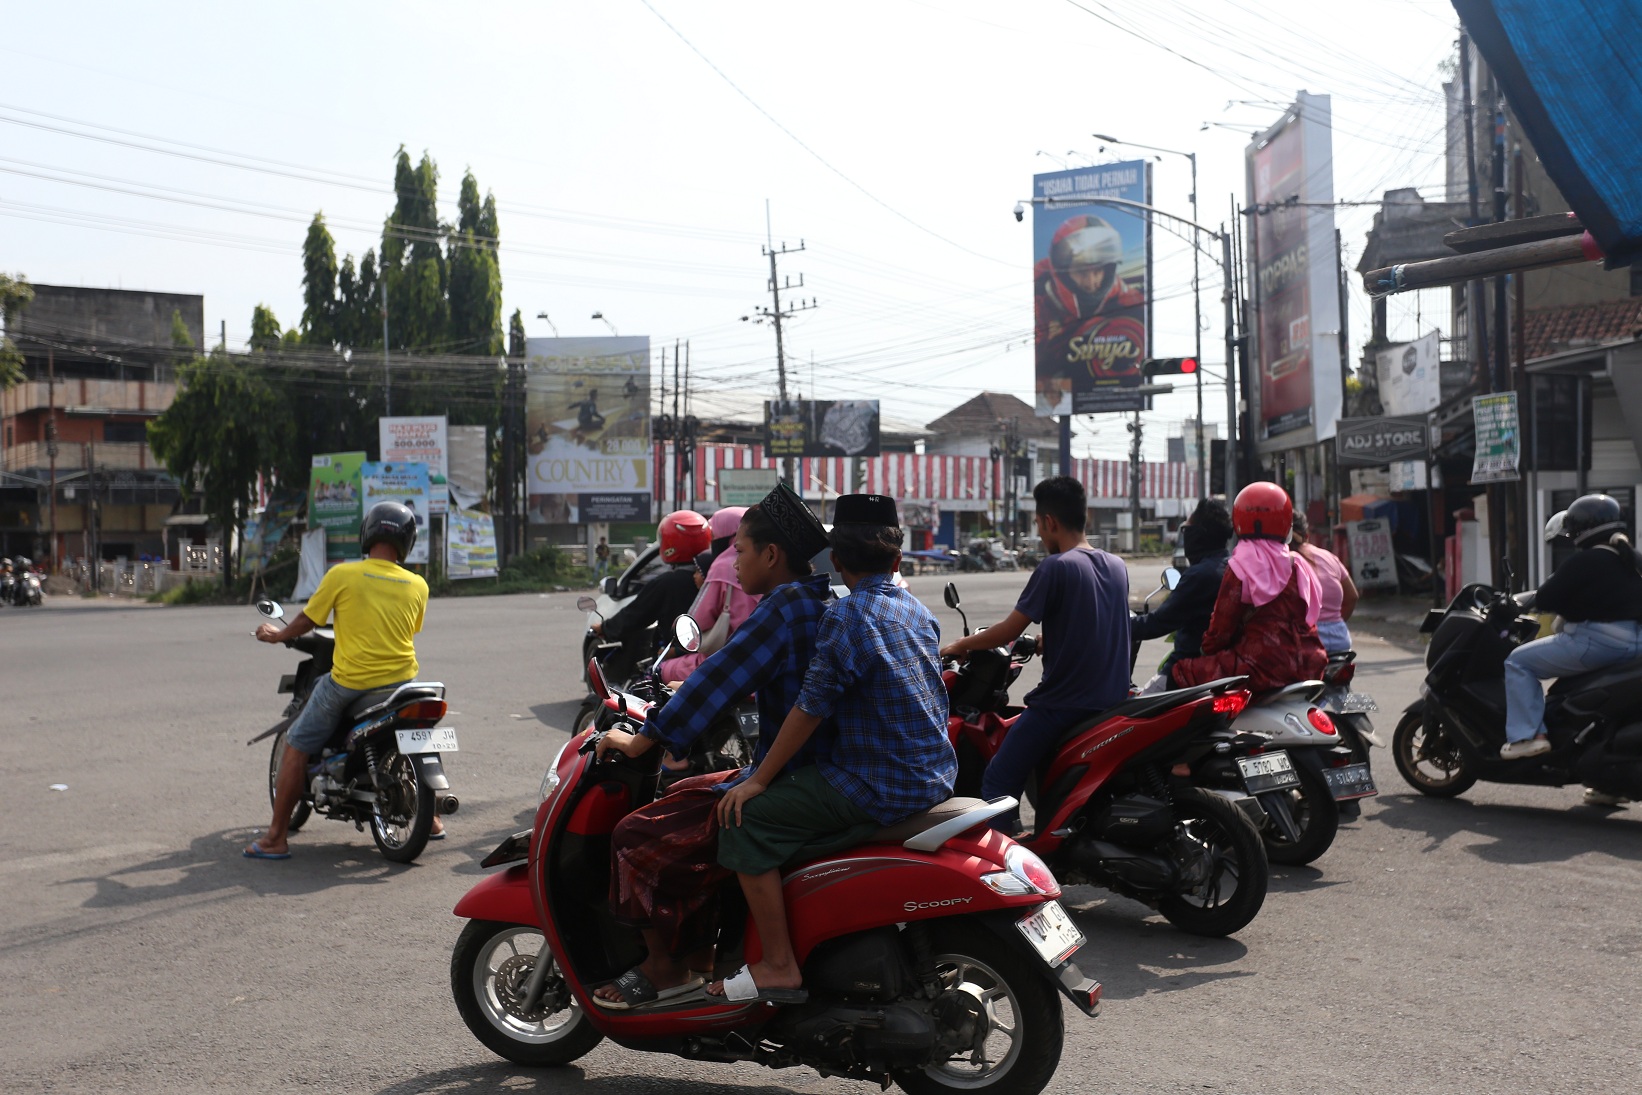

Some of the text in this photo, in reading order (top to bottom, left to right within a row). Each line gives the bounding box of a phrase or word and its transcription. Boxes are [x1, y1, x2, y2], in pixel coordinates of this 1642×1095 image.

[1075, 173, 1099, 191] TIDAK
[1101, 168, 1137, 187] PERNAH
[1067, 336, 1140, 370] Surya
[1345, 431, 1422, 449] ADJ STORE
[535, 458, 628, 482] COUNTRY
[399, 730, 455, 741] P 4591 JW
[1242, 764, 1248, 777] P
[1253, 760, 1274, 774] 5782
